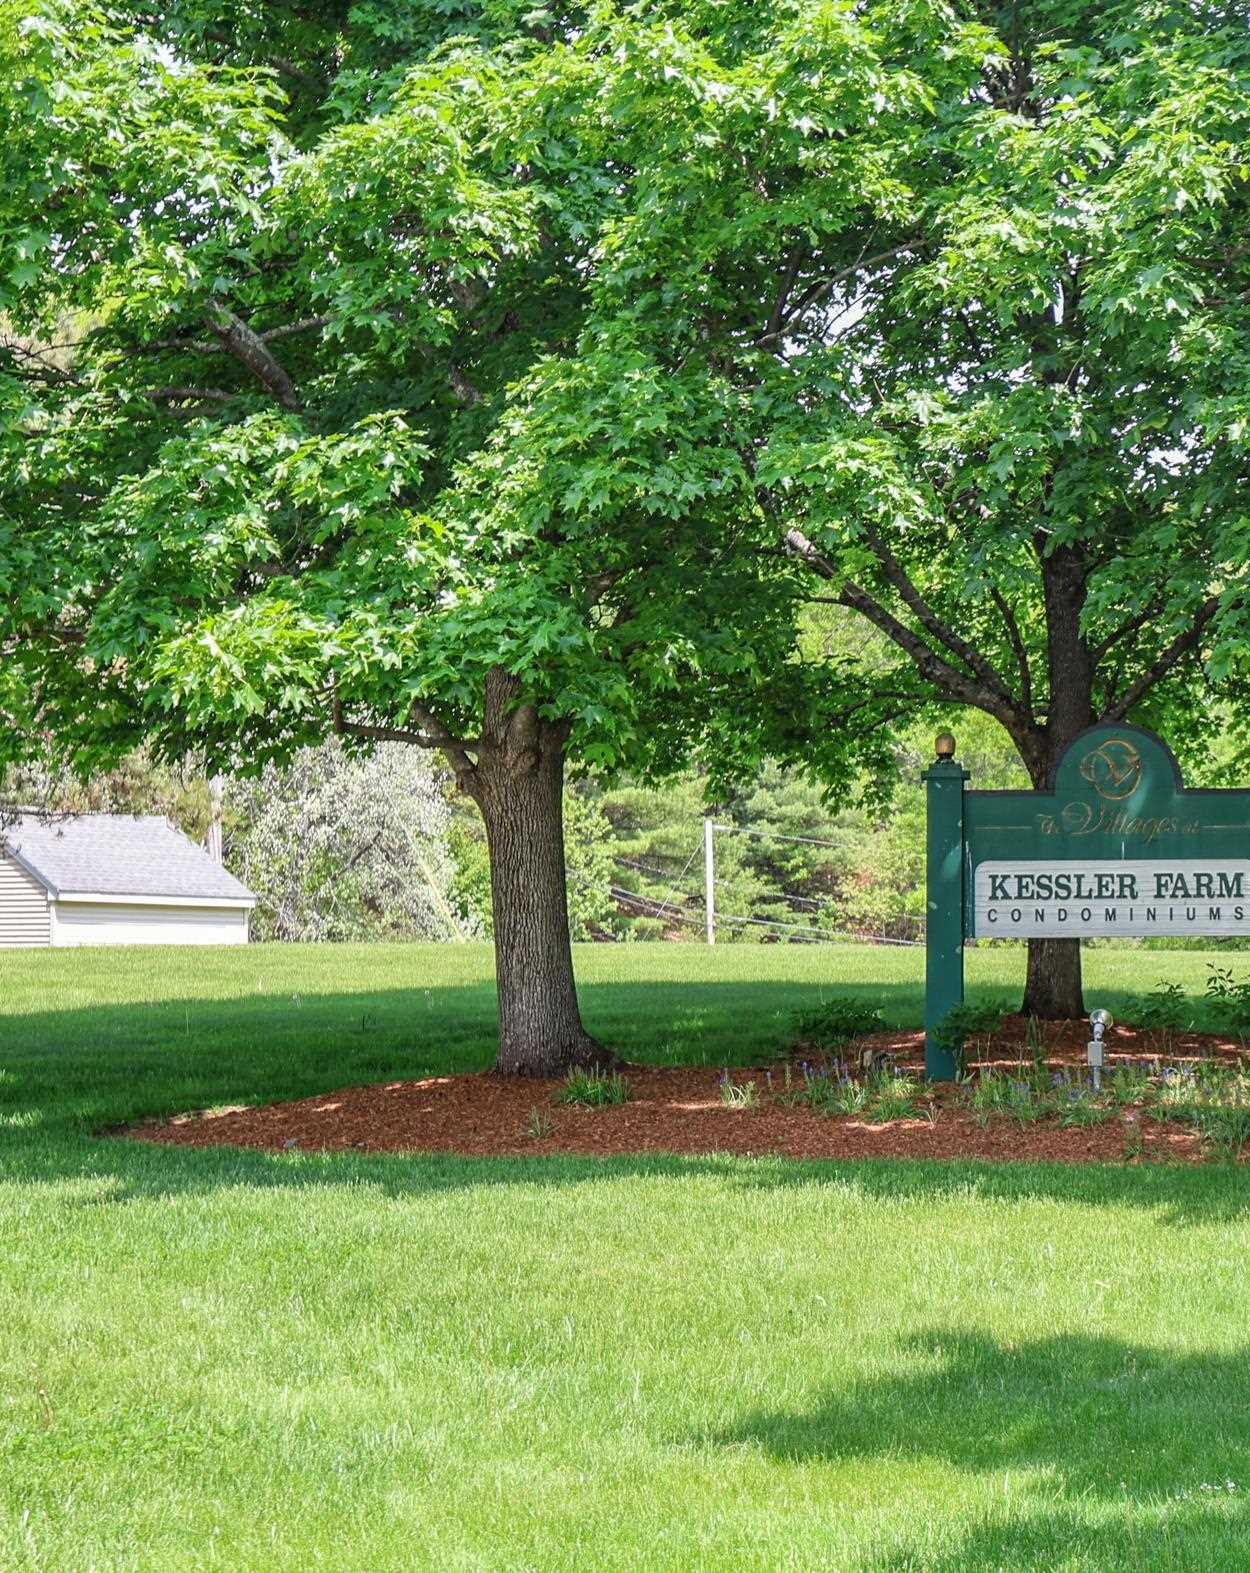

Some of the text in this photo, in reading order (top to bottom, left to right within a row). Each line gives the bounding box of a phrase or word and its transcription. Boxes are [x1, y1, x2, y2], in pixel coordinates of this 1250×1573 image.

[1061, 801, 1177, 842] Villages
[988, 872, 1244, 900] KESSLER FARM
[987, 906, 1244, 923] CONDOMINIUMS
